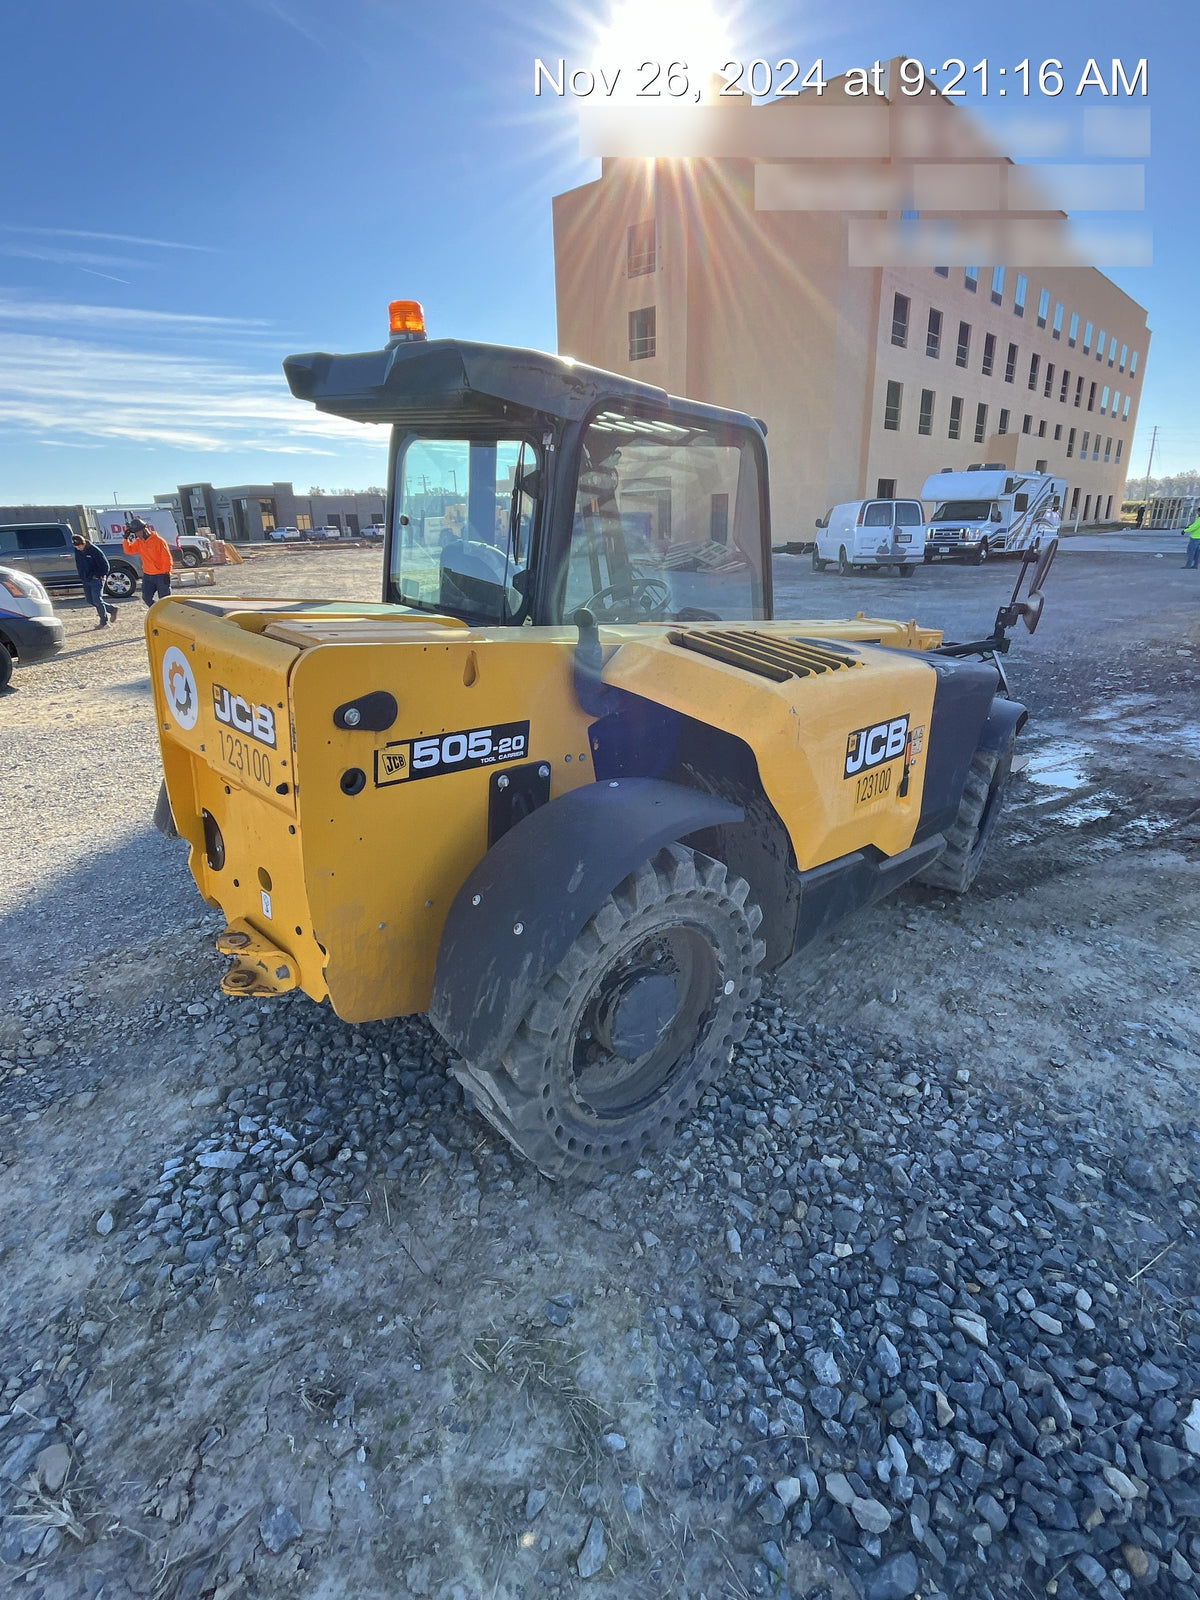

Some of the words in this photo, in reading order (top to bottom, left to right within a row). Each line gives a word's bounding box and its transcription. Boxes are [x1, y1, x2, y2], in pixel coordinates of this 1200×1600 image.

[214, 689, 276, 744] JCB
[219, 731, 271, 787] 123100
[384, 754, 406, 773] JCB
[412, 729, 525, 769] 505-20
[498, 750, 524, 761] CARRIER
[846, 718, 907, 773] JCB
[856, 767, 892, 804] 123100
